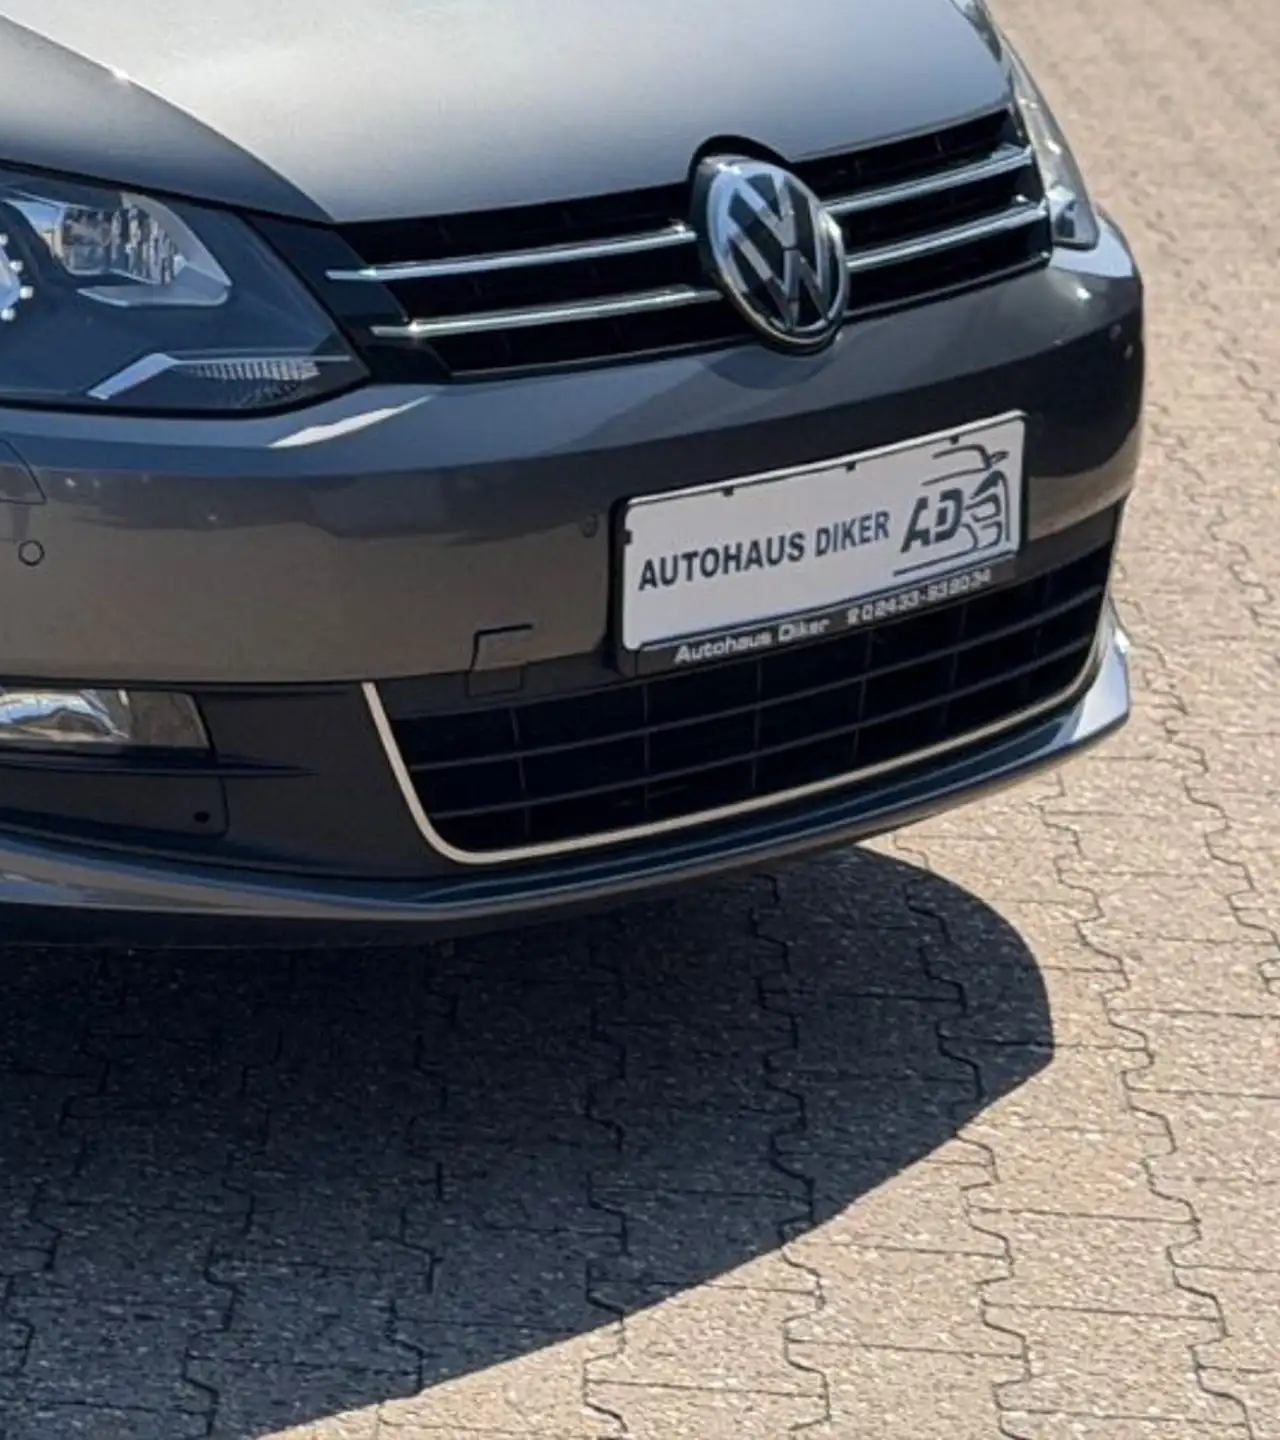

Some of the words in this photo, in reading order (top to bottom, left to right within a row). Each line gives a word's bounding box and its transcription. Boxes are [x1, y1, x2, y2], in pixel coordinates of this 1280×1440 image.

[707, 156, 843, 345] VW
[638, 530, 806, 592] AUTOHAUS
[814, 510, 890, 558] DIKER
[674, 631, 774, 665] Autohaus
[777, 618, 832, 643] Diker
